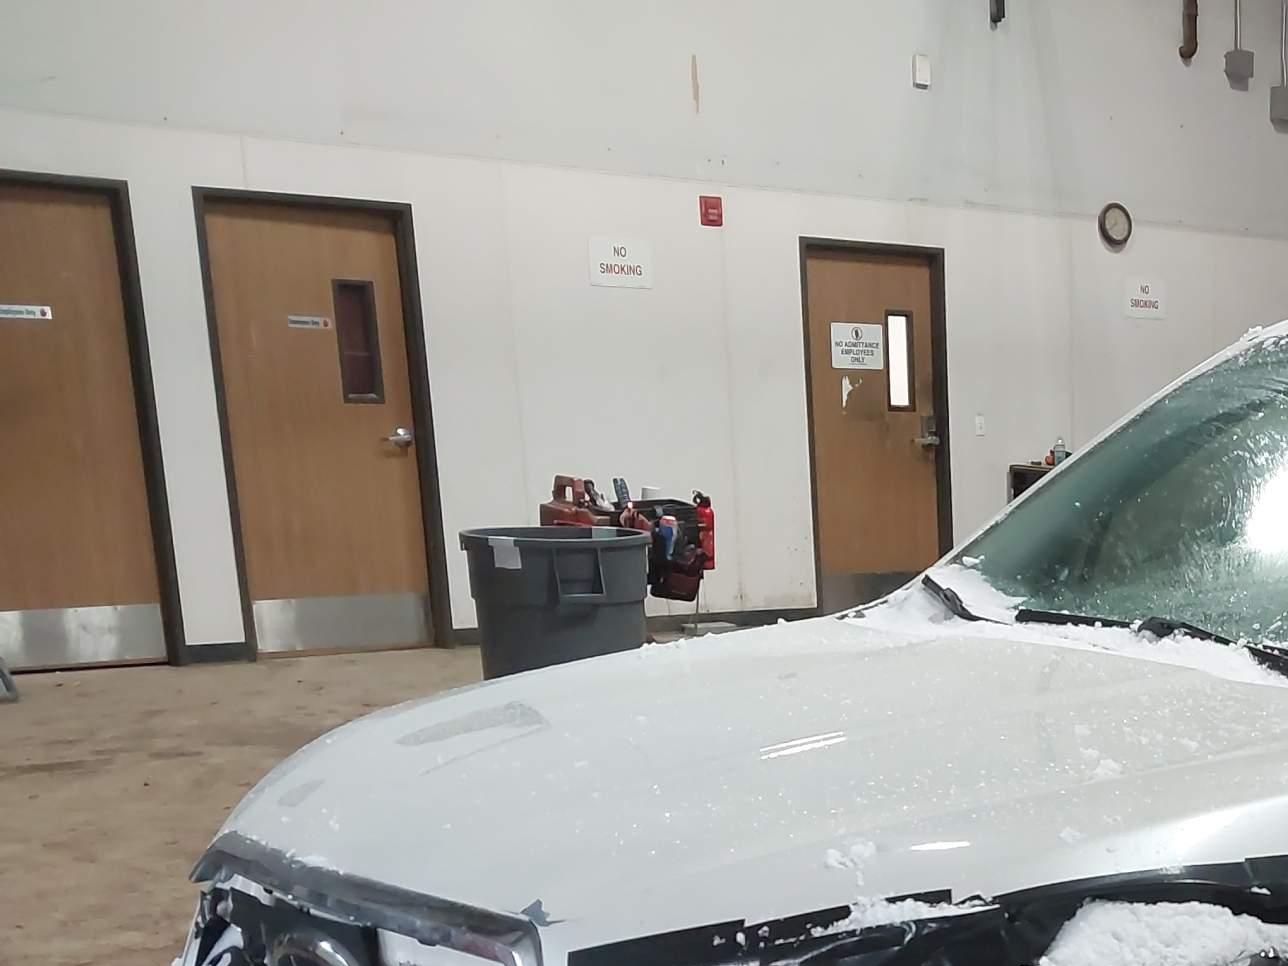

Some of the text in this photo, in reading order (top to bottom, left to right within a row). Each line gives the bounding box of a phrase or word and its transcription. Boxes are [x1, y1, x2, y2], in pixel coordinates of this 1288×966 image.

[613, 246, 627, 257] NO
[599, 262, 643, 276] SMOKING
[841, 348, 874, 356] EMPLOYEES
